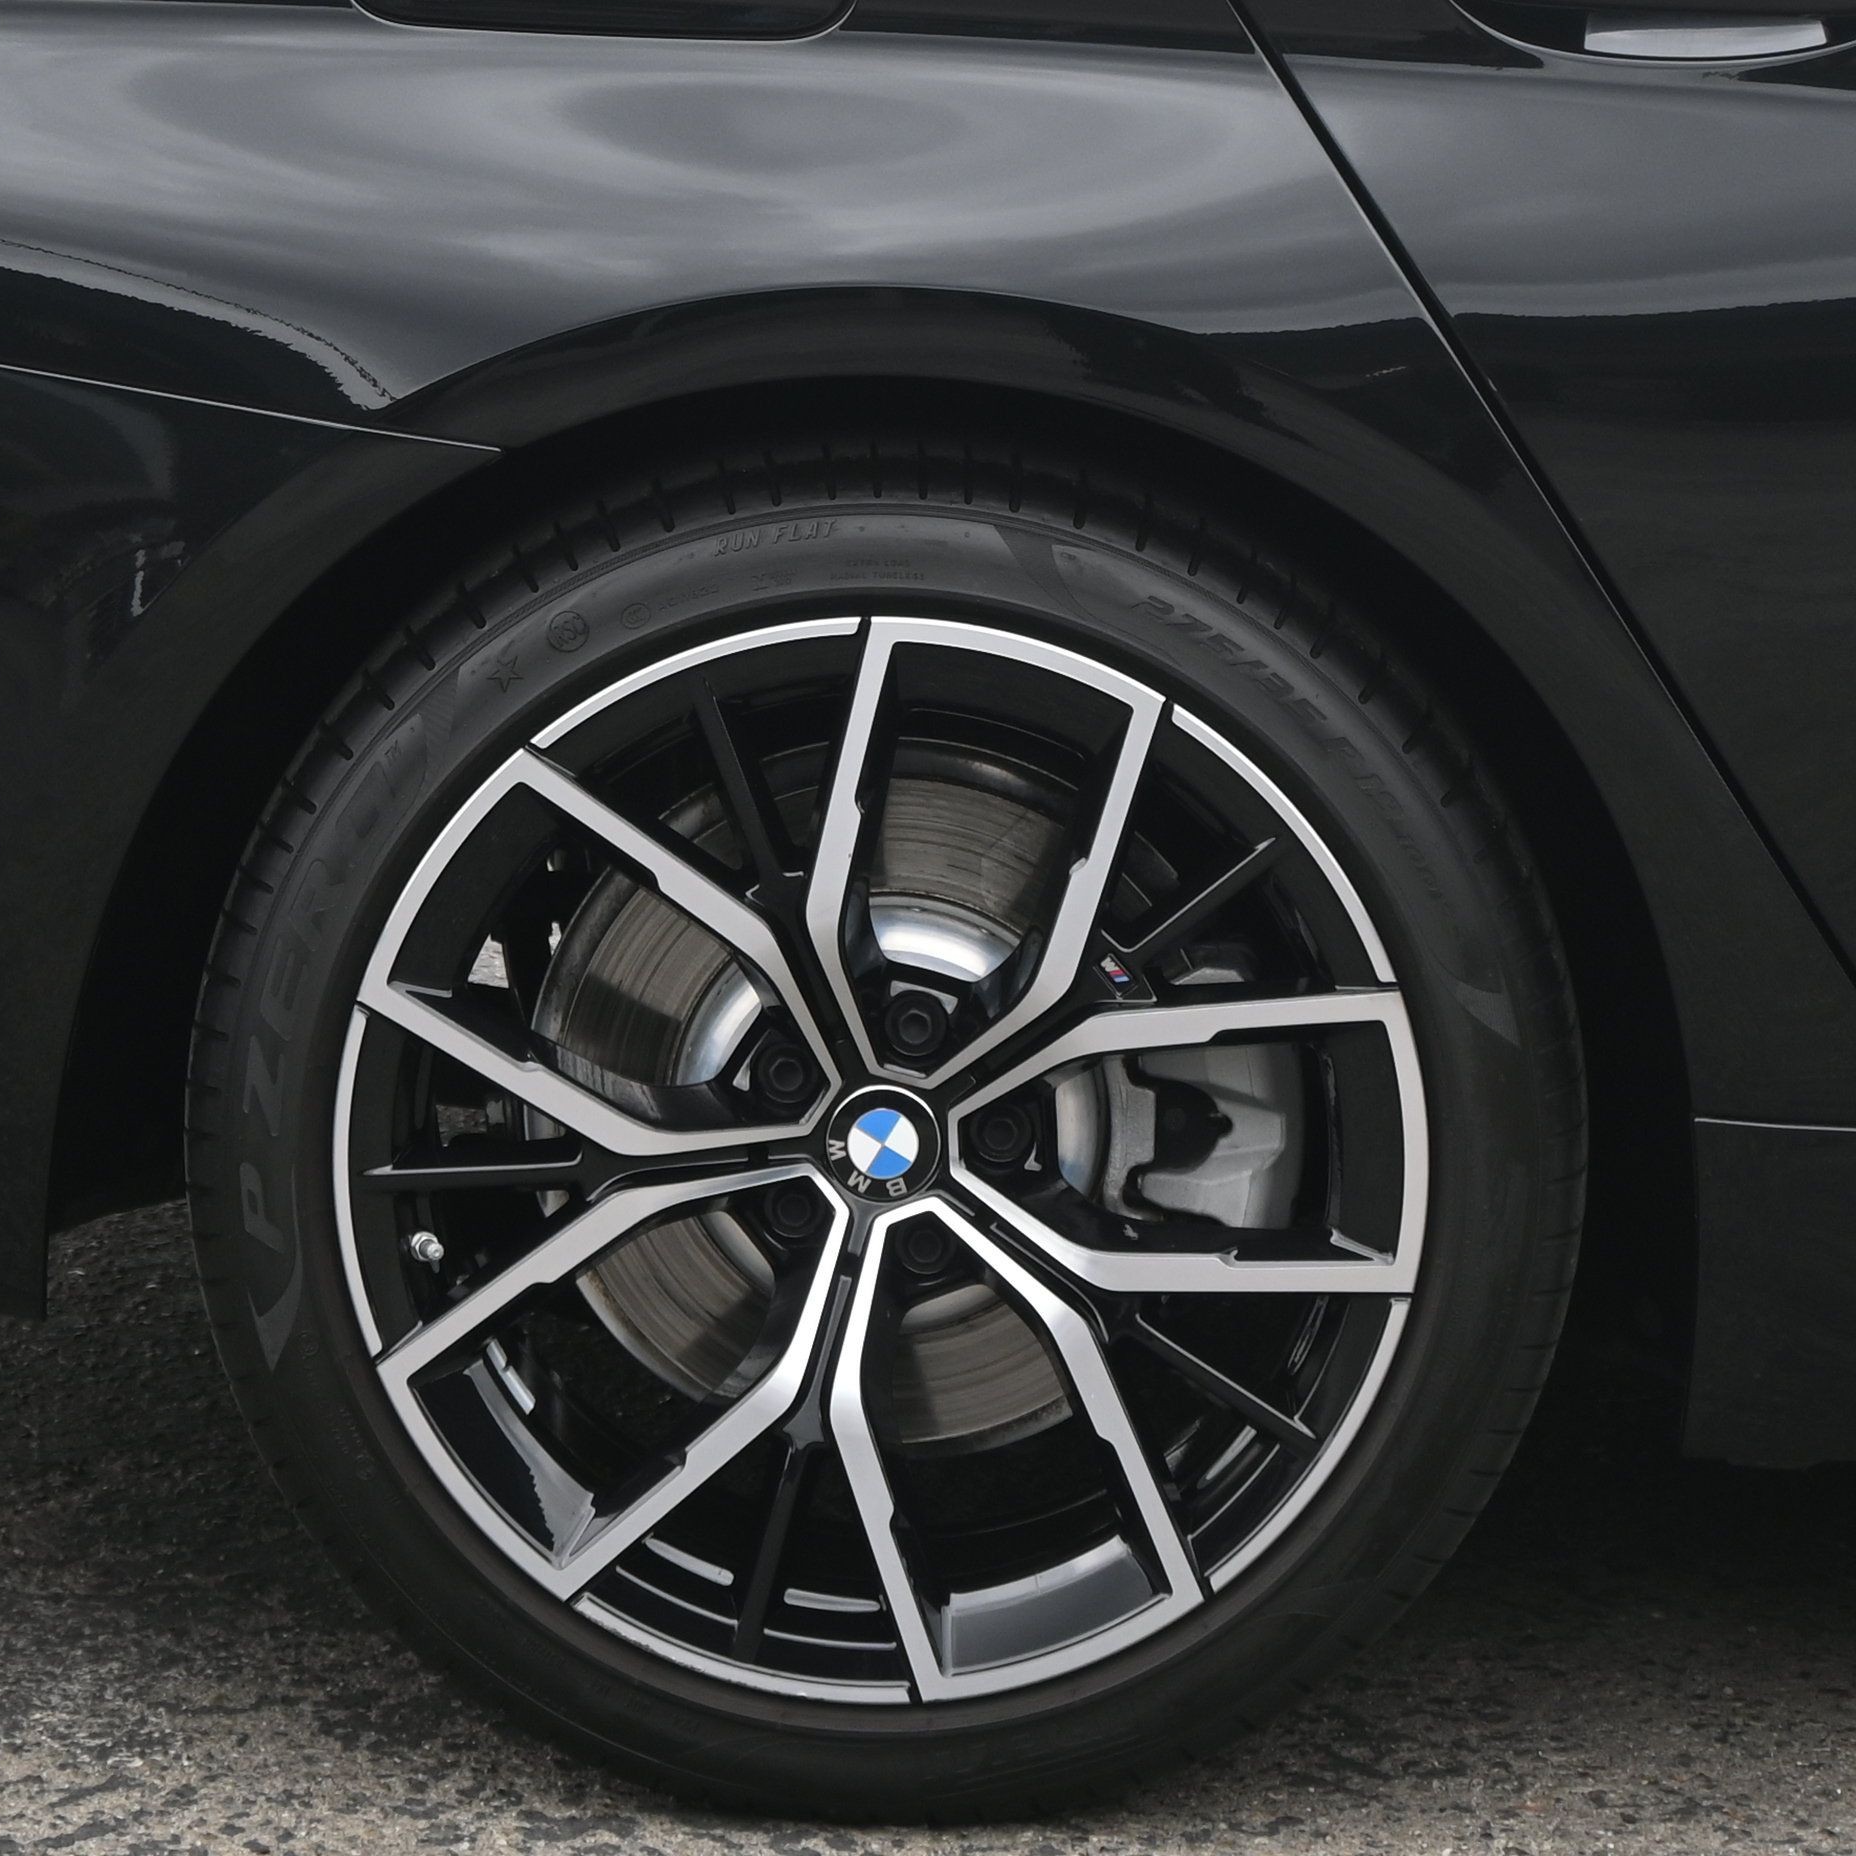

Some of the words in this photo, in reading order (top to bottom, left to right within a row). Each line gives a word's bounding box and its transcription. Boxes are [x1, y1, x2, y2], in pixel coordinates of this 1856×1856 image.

[713, 529, 761, 557] RUN
[772, 519, 836, 545] FLAT
[1131, 595, 1327, 724] 275/35
[244, 760, 397, 1137] ZERO
[240, 1161, 286, 1255] P
[827, 1138, 908, 1198] BMW
